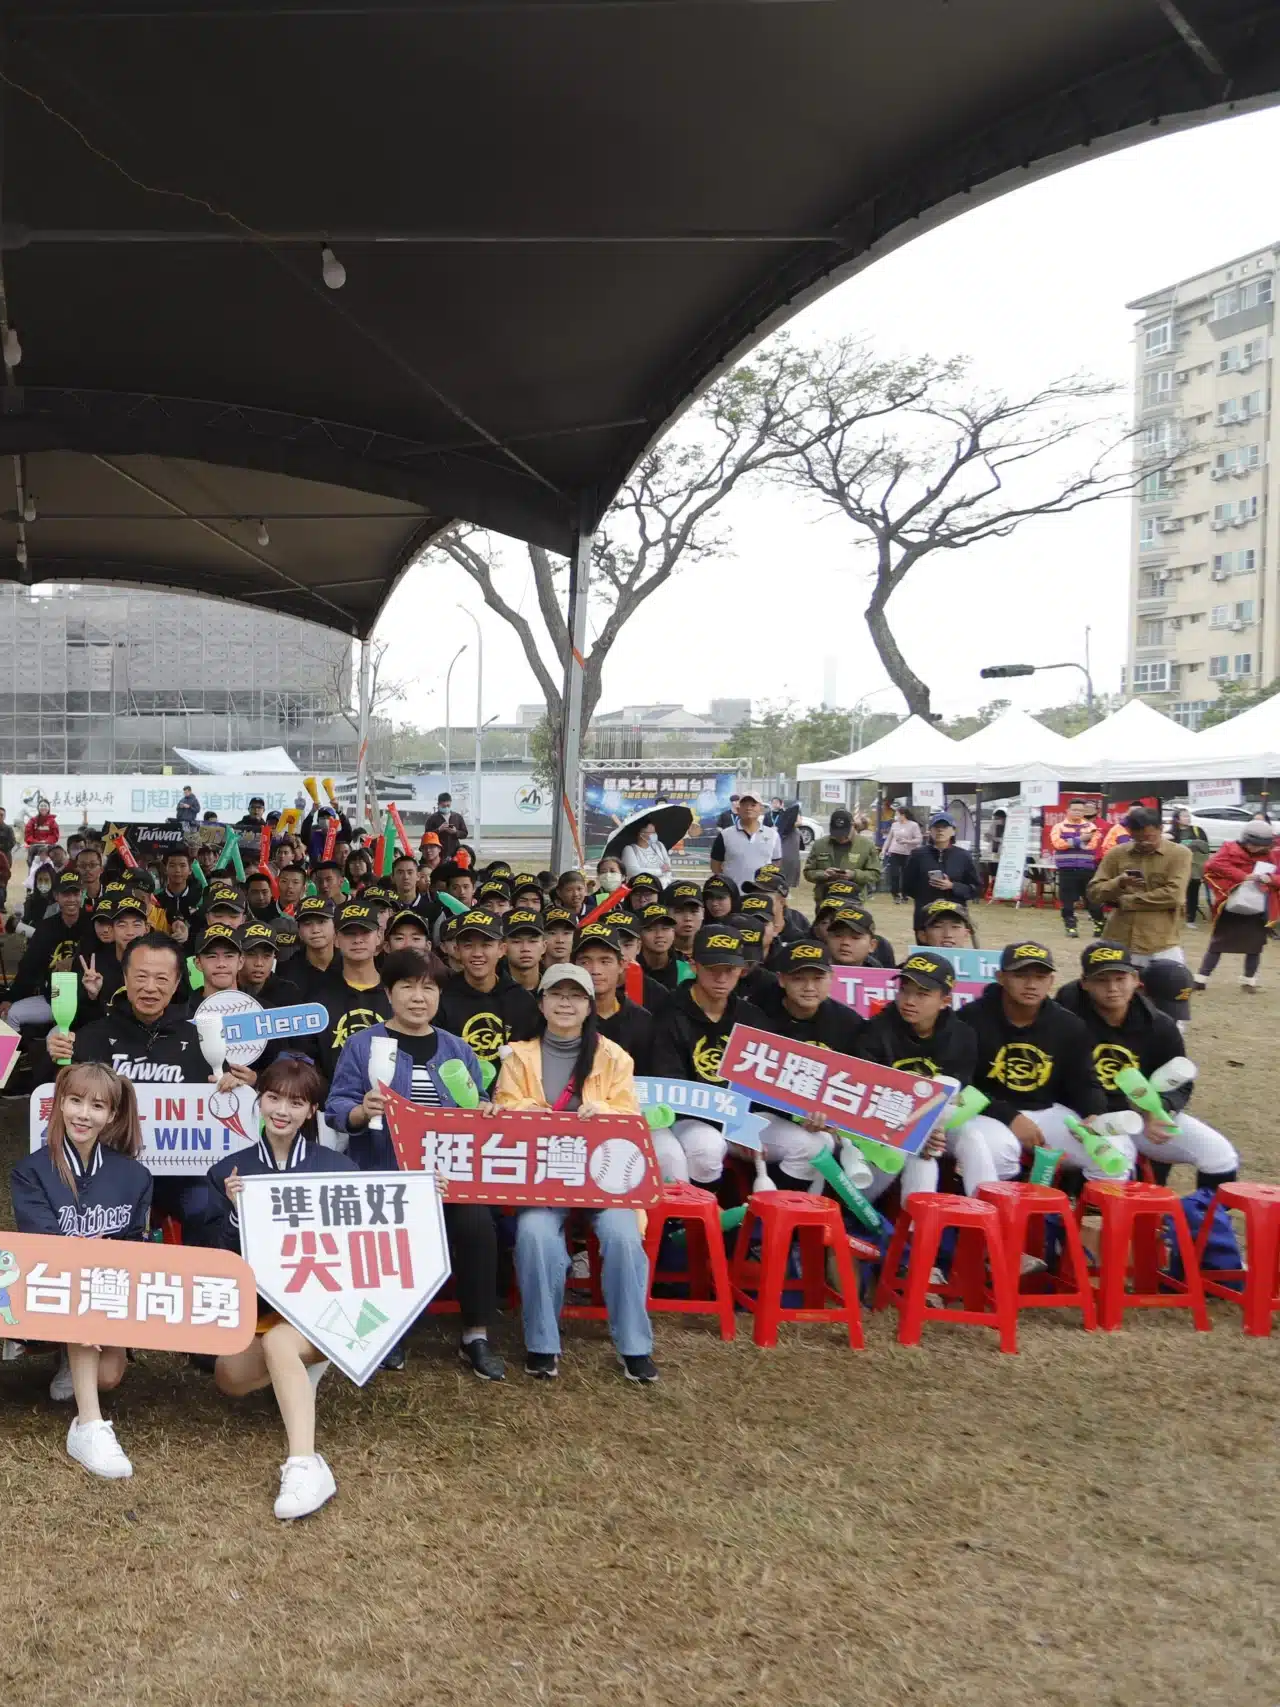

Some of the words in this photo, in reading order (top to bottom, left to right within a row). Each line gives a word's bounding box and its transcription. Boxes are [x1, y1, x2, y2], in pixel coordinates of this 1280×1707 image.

[137, 827, 183, 842] Taiwan
[255, 1012, 321, 1036] Hero
[112, 1054, 185, 1083] Taiwan
[733, 1040, 916, 1131] 光躍台灣
[421, 1130, 588, 1186] 挺台灣
[270, 1183, 409, 1227] 準備好
[280, 1228, 415, 1293] 尖叫
[25, 1262, 240, 1328] 台灣尚勇
